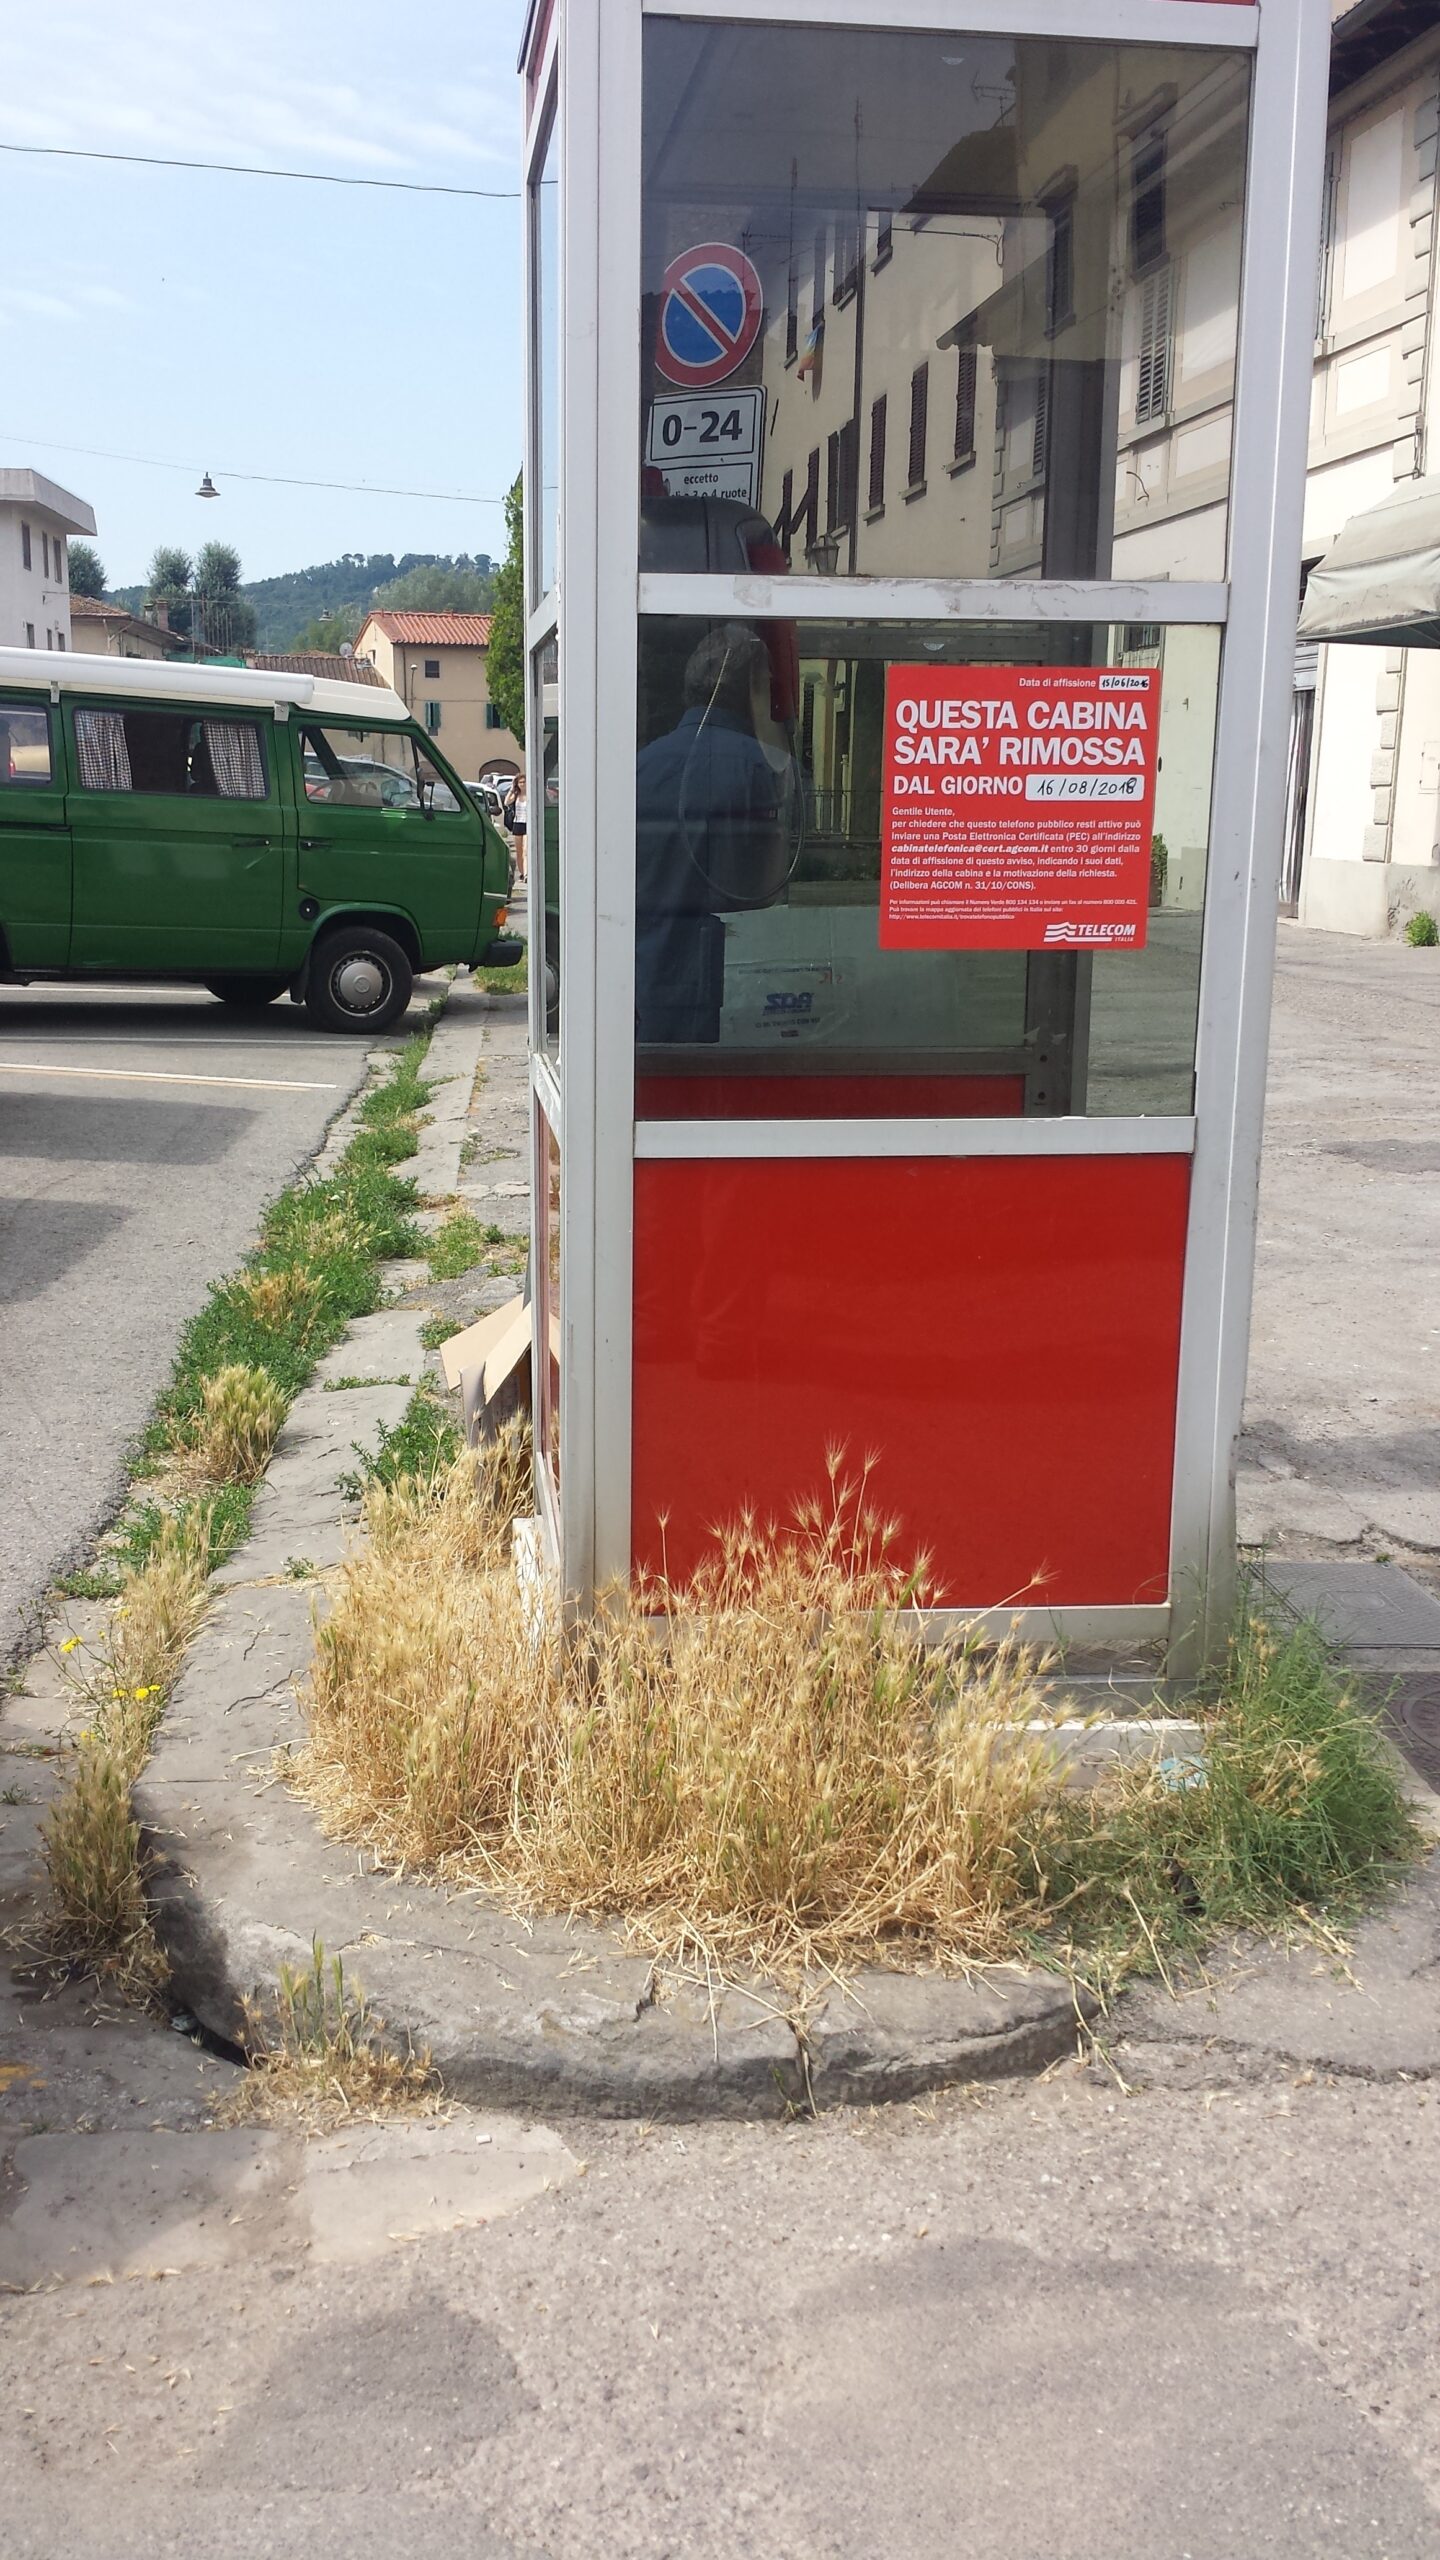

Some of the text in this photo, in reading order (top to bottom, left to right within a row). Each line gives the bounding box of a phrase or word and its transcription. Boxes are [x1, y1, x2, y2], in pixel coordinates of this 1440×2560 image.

[662, 410, 743, 446] 0-24
[684, 473, 719, 484] eccetto
[721, 488, 747, 499] ruote
[1019, 678, 1040, 686] Data
[1053, 679, 1096, 687] affissione
[895, 699, 1148, 734] QUESTA CABINA
[894, 736, 1145, 765] SARA' RIMOSSA
[894, 776, 935, 794] DAL
[941, 776, 1023, 794] GIORNO
[892, 806, 955, 816] Gentile Utente,
[892, 819, 1141, 829] per chiedere che questo telefono pubblico resti attivo può
[942, 831, 966, 840] Posta
[970, 832, 1016, 840] Elettronica
[1019, 832, 1064, 840] Certificata
[1066, 832, 1090, 841] (PEC)
[891, 845, 1049, 854] cabinatelefonica@cert.agcom.it
[1076, 844, 1088, 852] 30
[1091, 845, 1115, 854] giorni
[1118, 844, 1140, 852] dalla
[891, 856, 910, 864] data
[912, 856, 920, 864] di
[922, 856, 964, 864] affissione
[966, 856, 974, 864] di
[976, 857, 1004, 866] questo
[1006, 858, 1035, 866] avviso,
[1037, 856, 1078, 864] indicando
[1104, 857, 1123, 866] dati,
[932, 868, 952, 876] della
[955, 869, 983, 877] cabina
[1003, 869, 1055, 877] motivazione
[1056, 868, 1077, 877] della
[1079, 869, 1117, 877] richiesta.
[890, 881, 928, 890] (Delibera
[930, 880, 963, 889] AGCOM
[975, 881, 1037, 890] 31/10/CONS).
[1078, 924, 1136, 936] TELECOM
